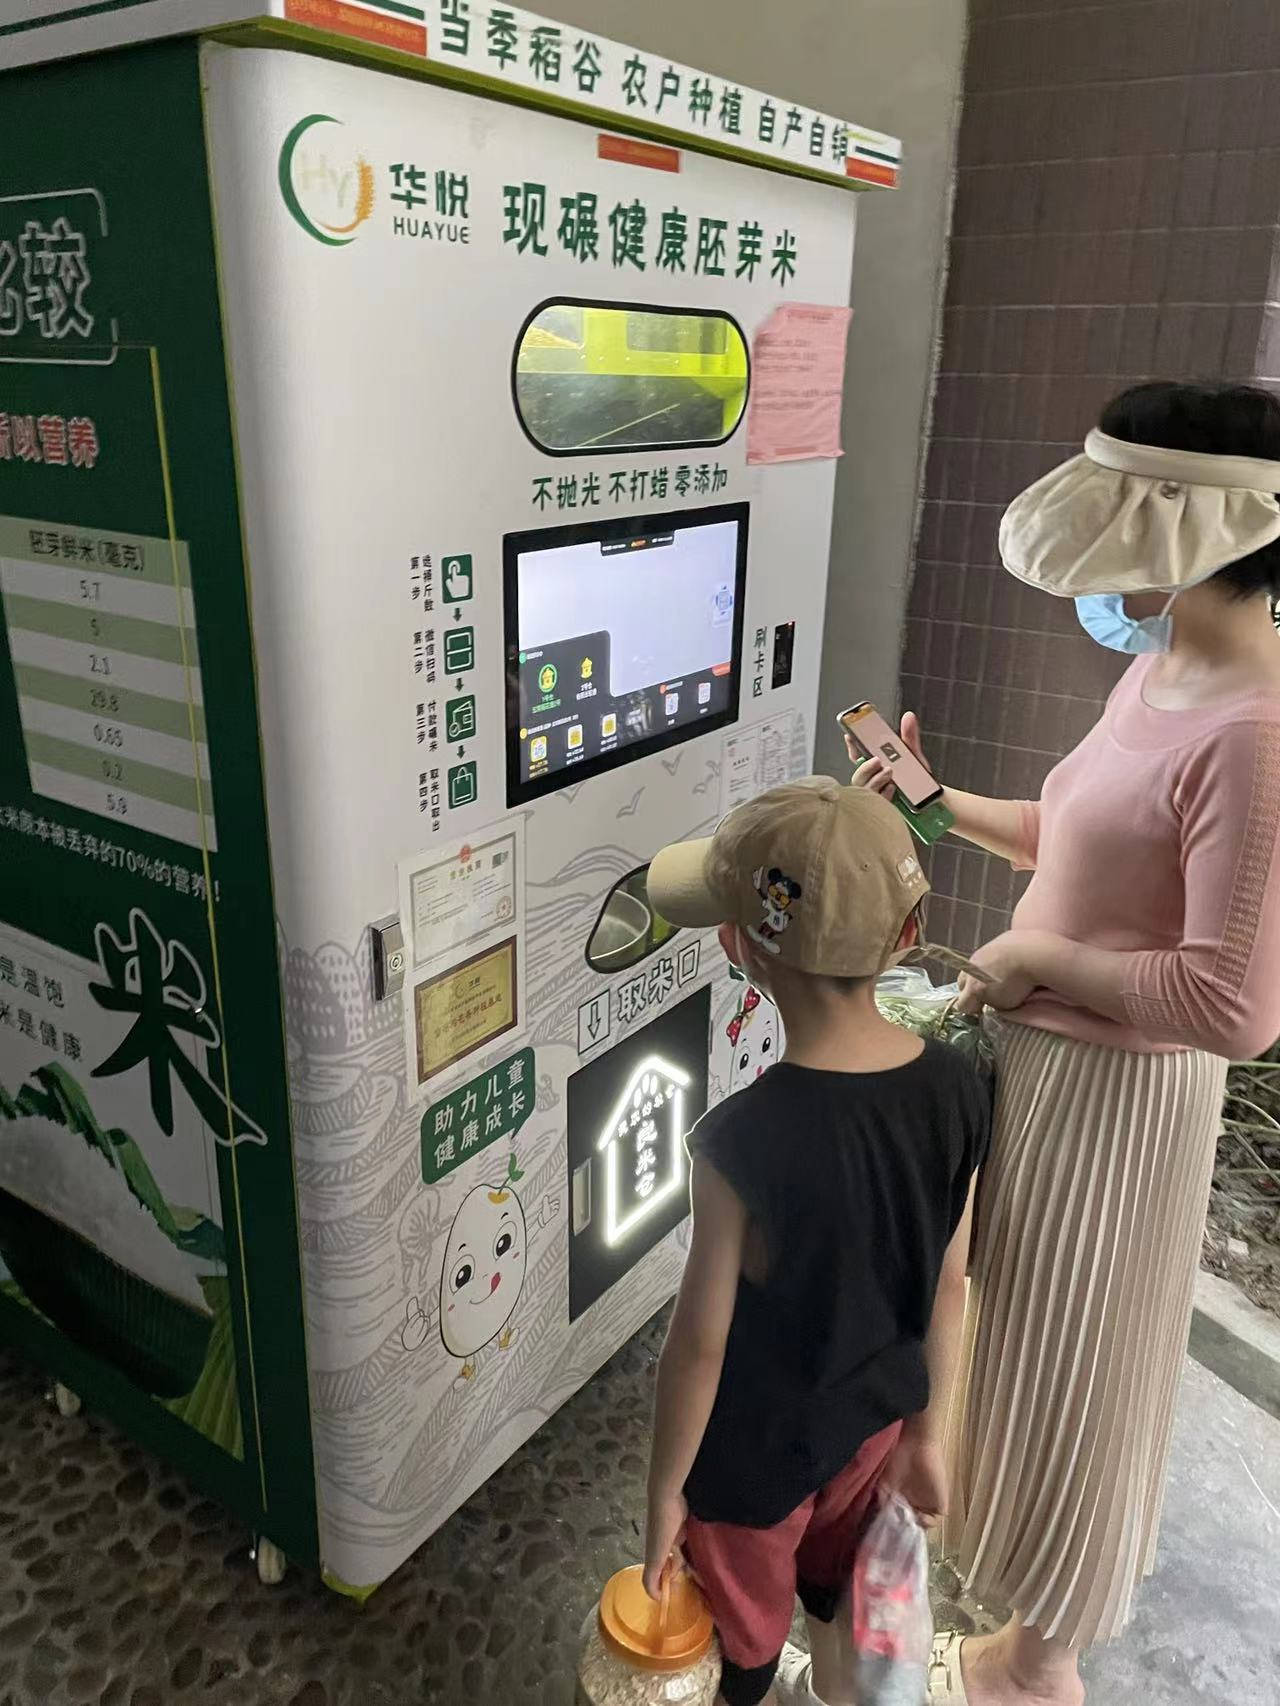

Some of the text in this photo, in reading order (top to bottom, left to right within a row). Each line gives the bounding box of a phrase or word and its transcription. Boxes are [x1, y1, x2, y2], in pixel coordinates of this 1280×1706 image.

[440, 0, 849, 164] 当季稻谷 农户种植 自产自销
[389, 163, 469, 218] 华悦
[394, 216, 470, 244] HUAYUE
[503, 183, 797, 287] 现碾健康胚芽米
[532, 462, 728, 511] 不抛光 不打蜡 零添加
[753, 626, 767, 697] 刷卡区
[617, 940, 701, 1024] 取米口
[88, 907, 268, 1147] 米
[434, 1059, 525, 1135] 助力儿童
[434, 1090, 526, 1168] 健康成长
